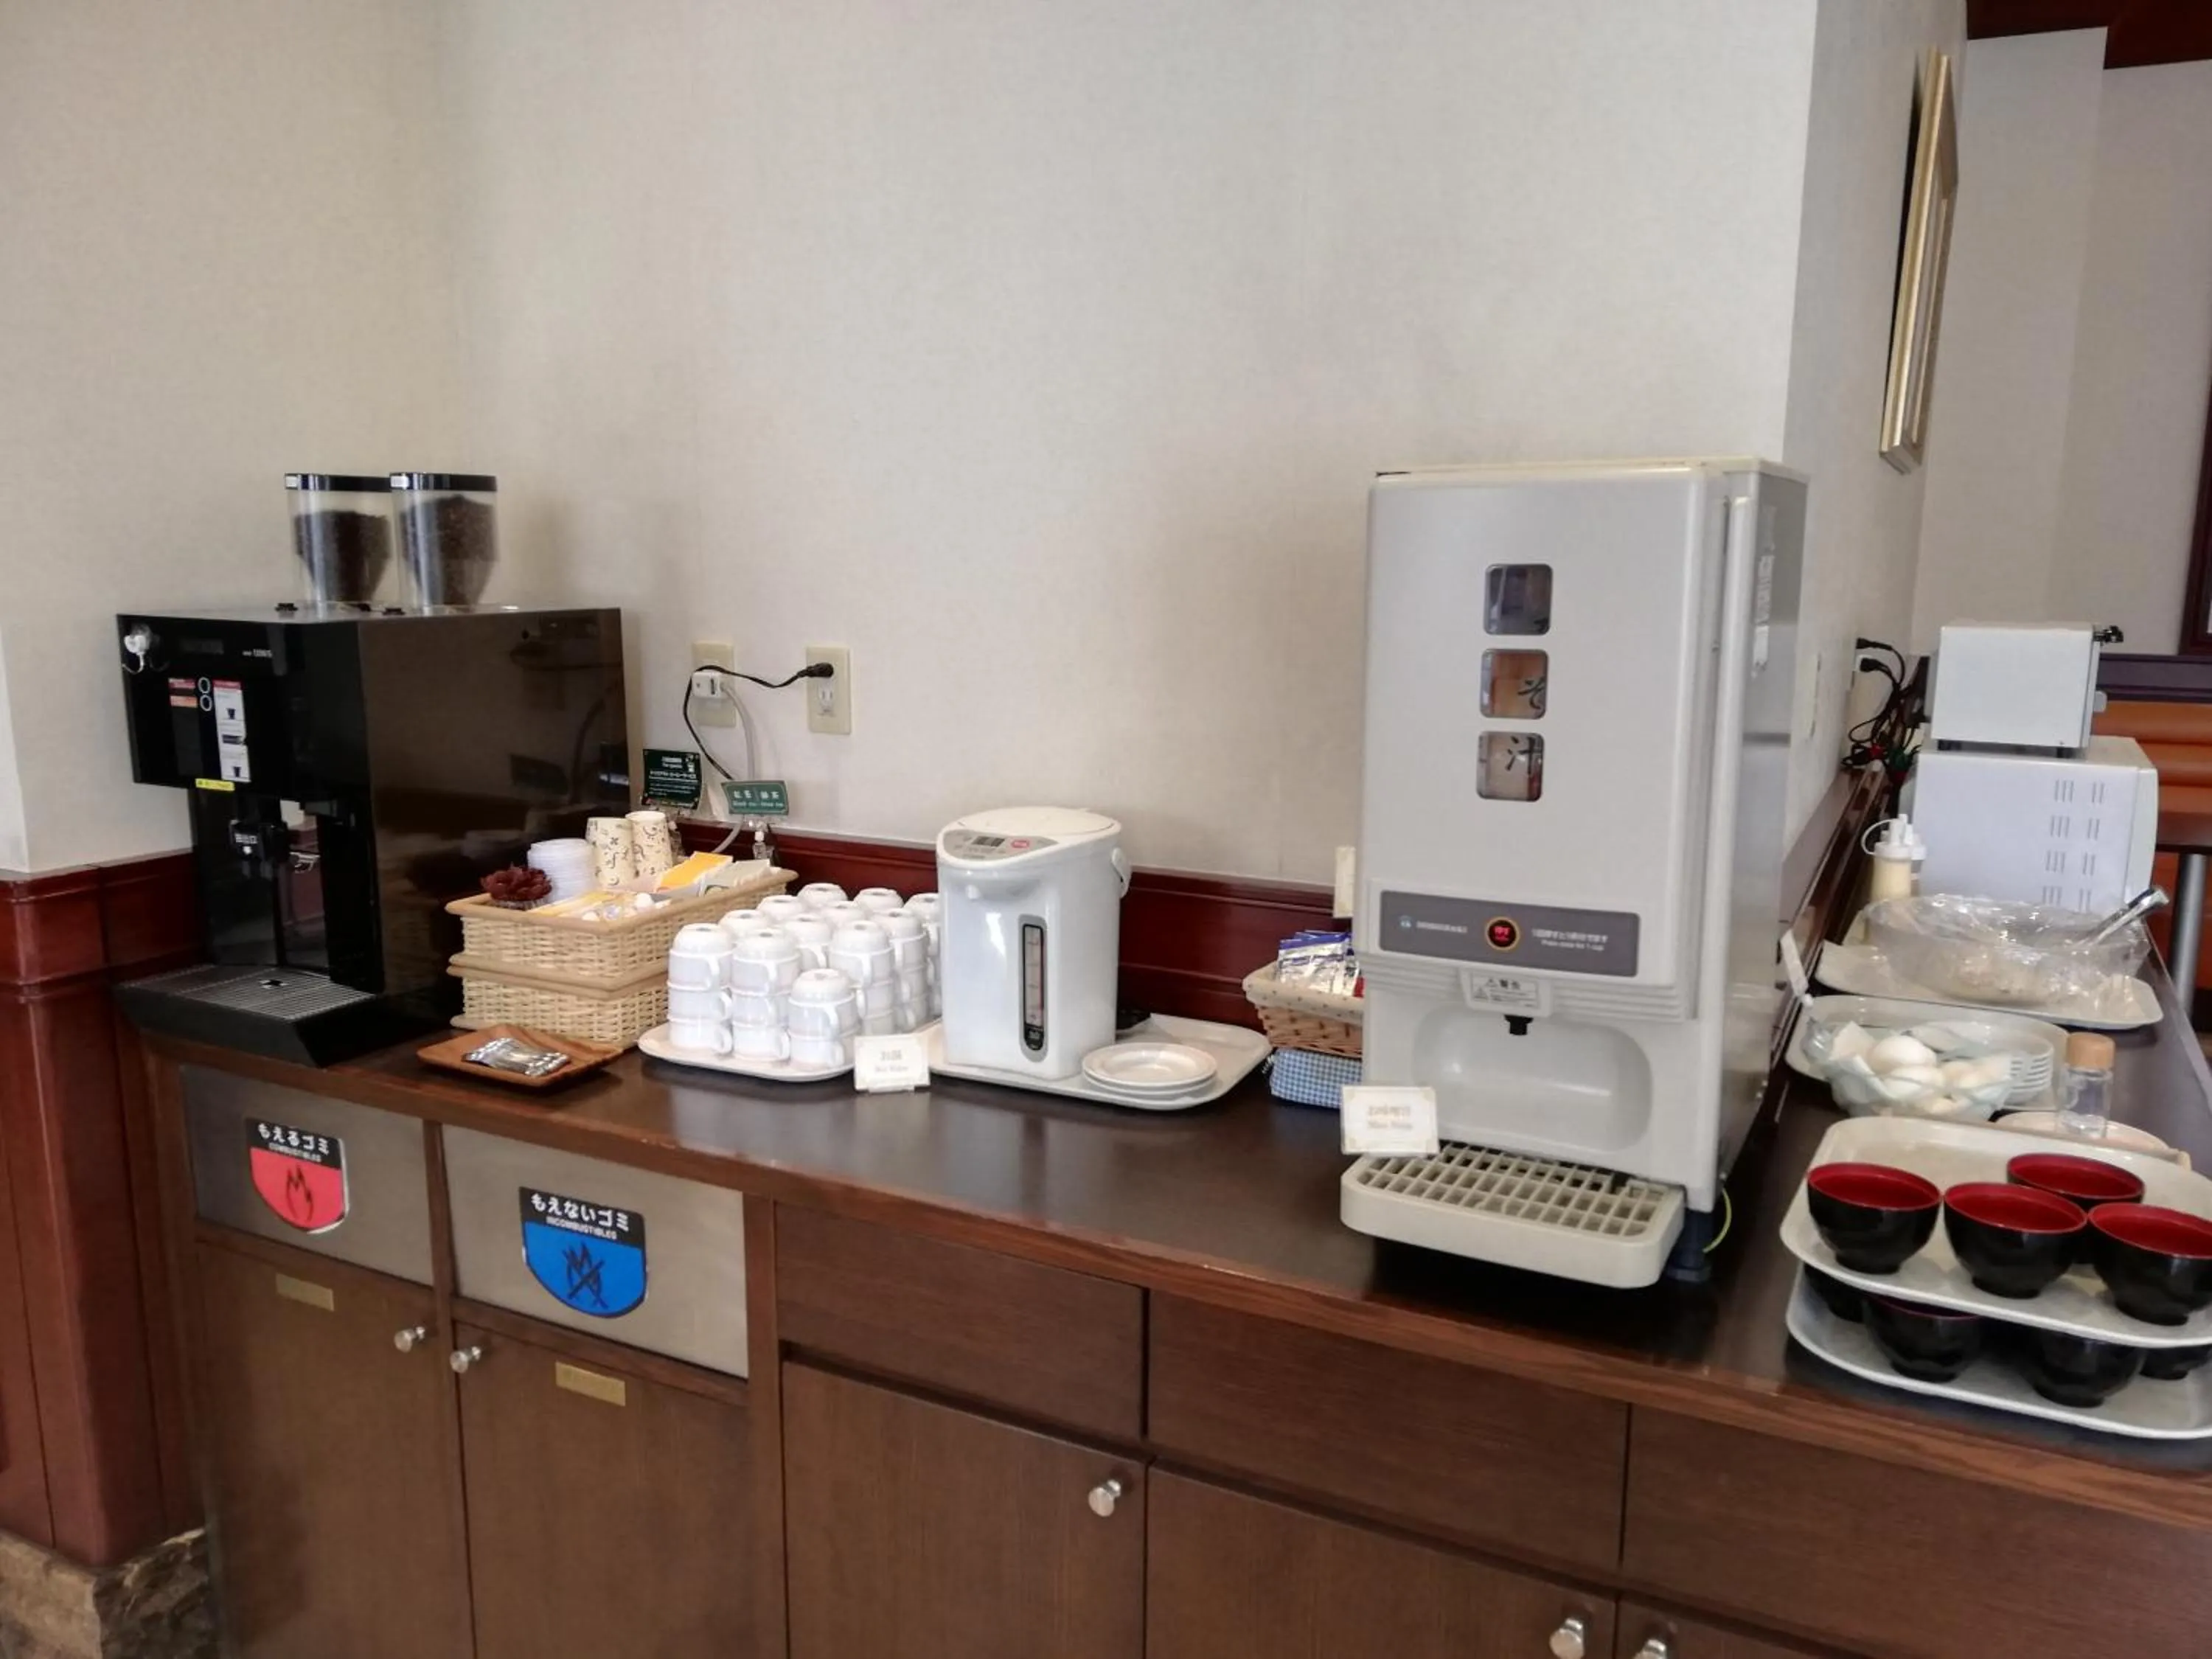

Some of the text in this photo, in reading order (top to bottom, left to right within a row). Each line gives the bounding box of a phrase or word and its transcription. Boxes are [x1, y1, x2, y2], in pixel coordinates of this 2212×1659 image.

[258, 1123, 329, 1156] もえるゴミ
[531, 1194, 630, 1232] もえないゴミ
